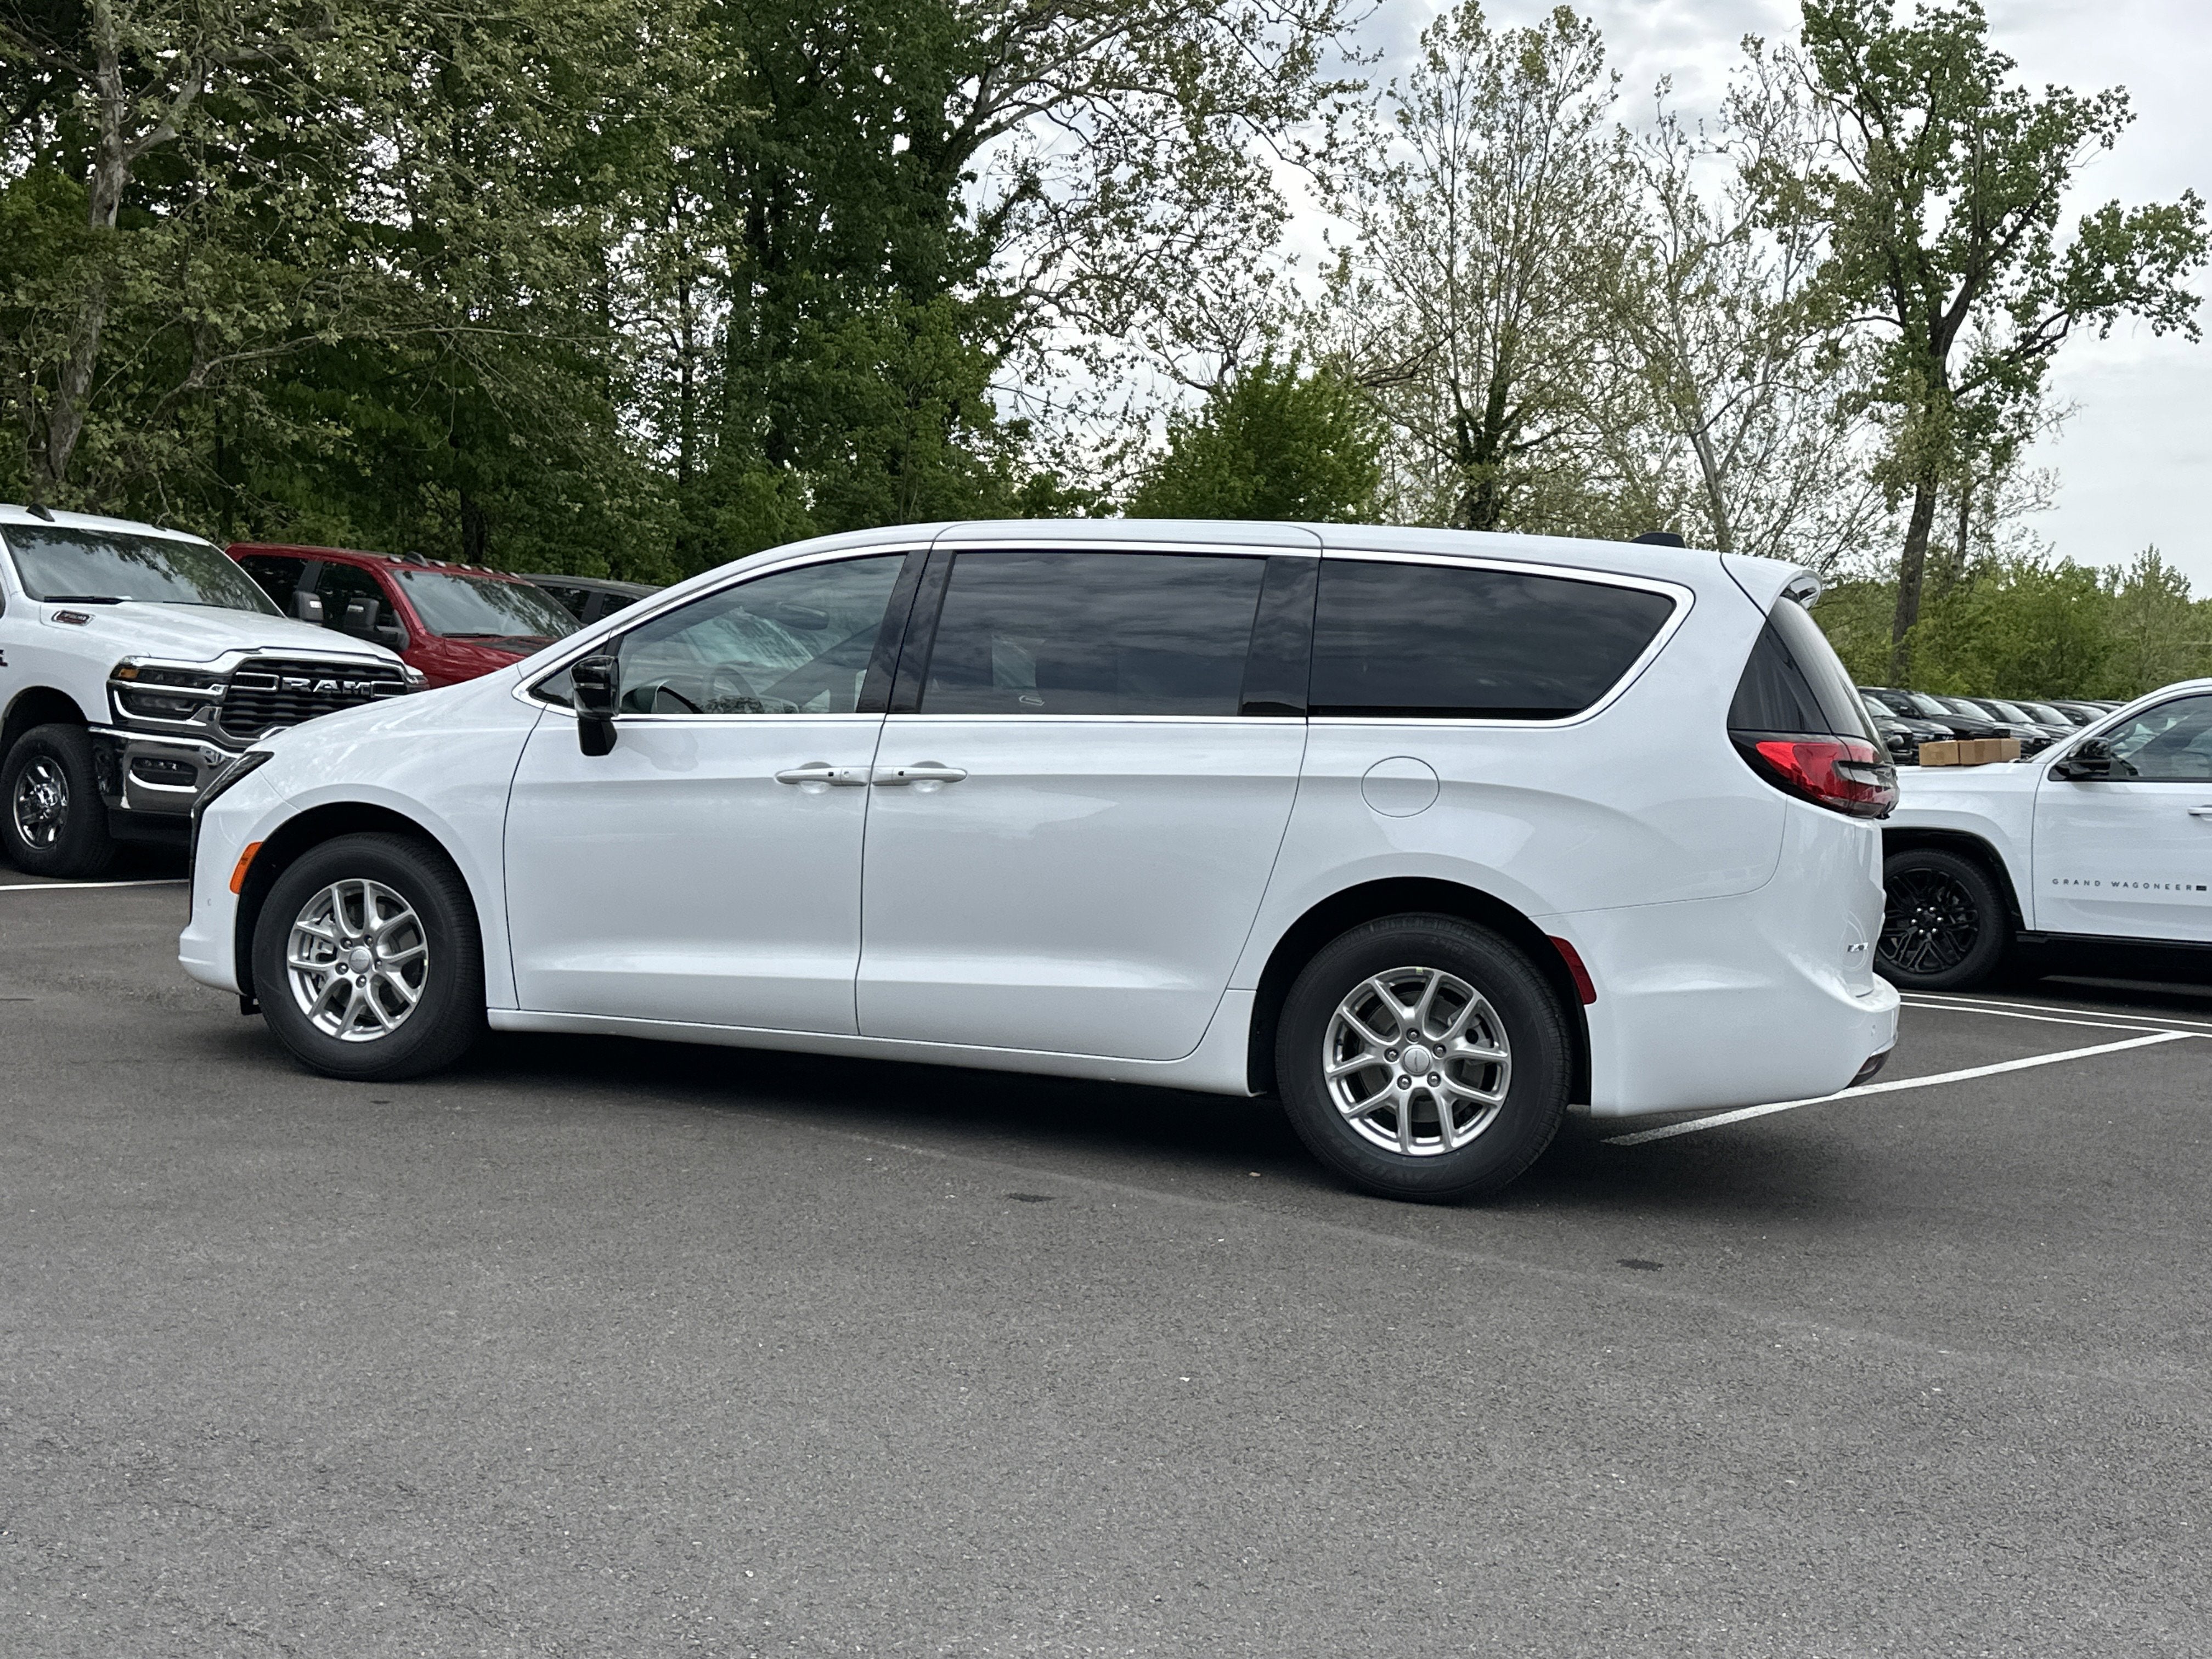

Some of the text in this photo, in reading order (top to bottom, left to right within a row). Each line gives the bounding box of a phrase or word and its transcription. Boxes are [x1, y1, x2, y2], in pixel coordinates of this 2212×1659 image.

[282, 676, 371, 695] RAM
[2052, 878, 2101, 887] GRAND
[2111, 881, 2192, 891] WAGONEER
